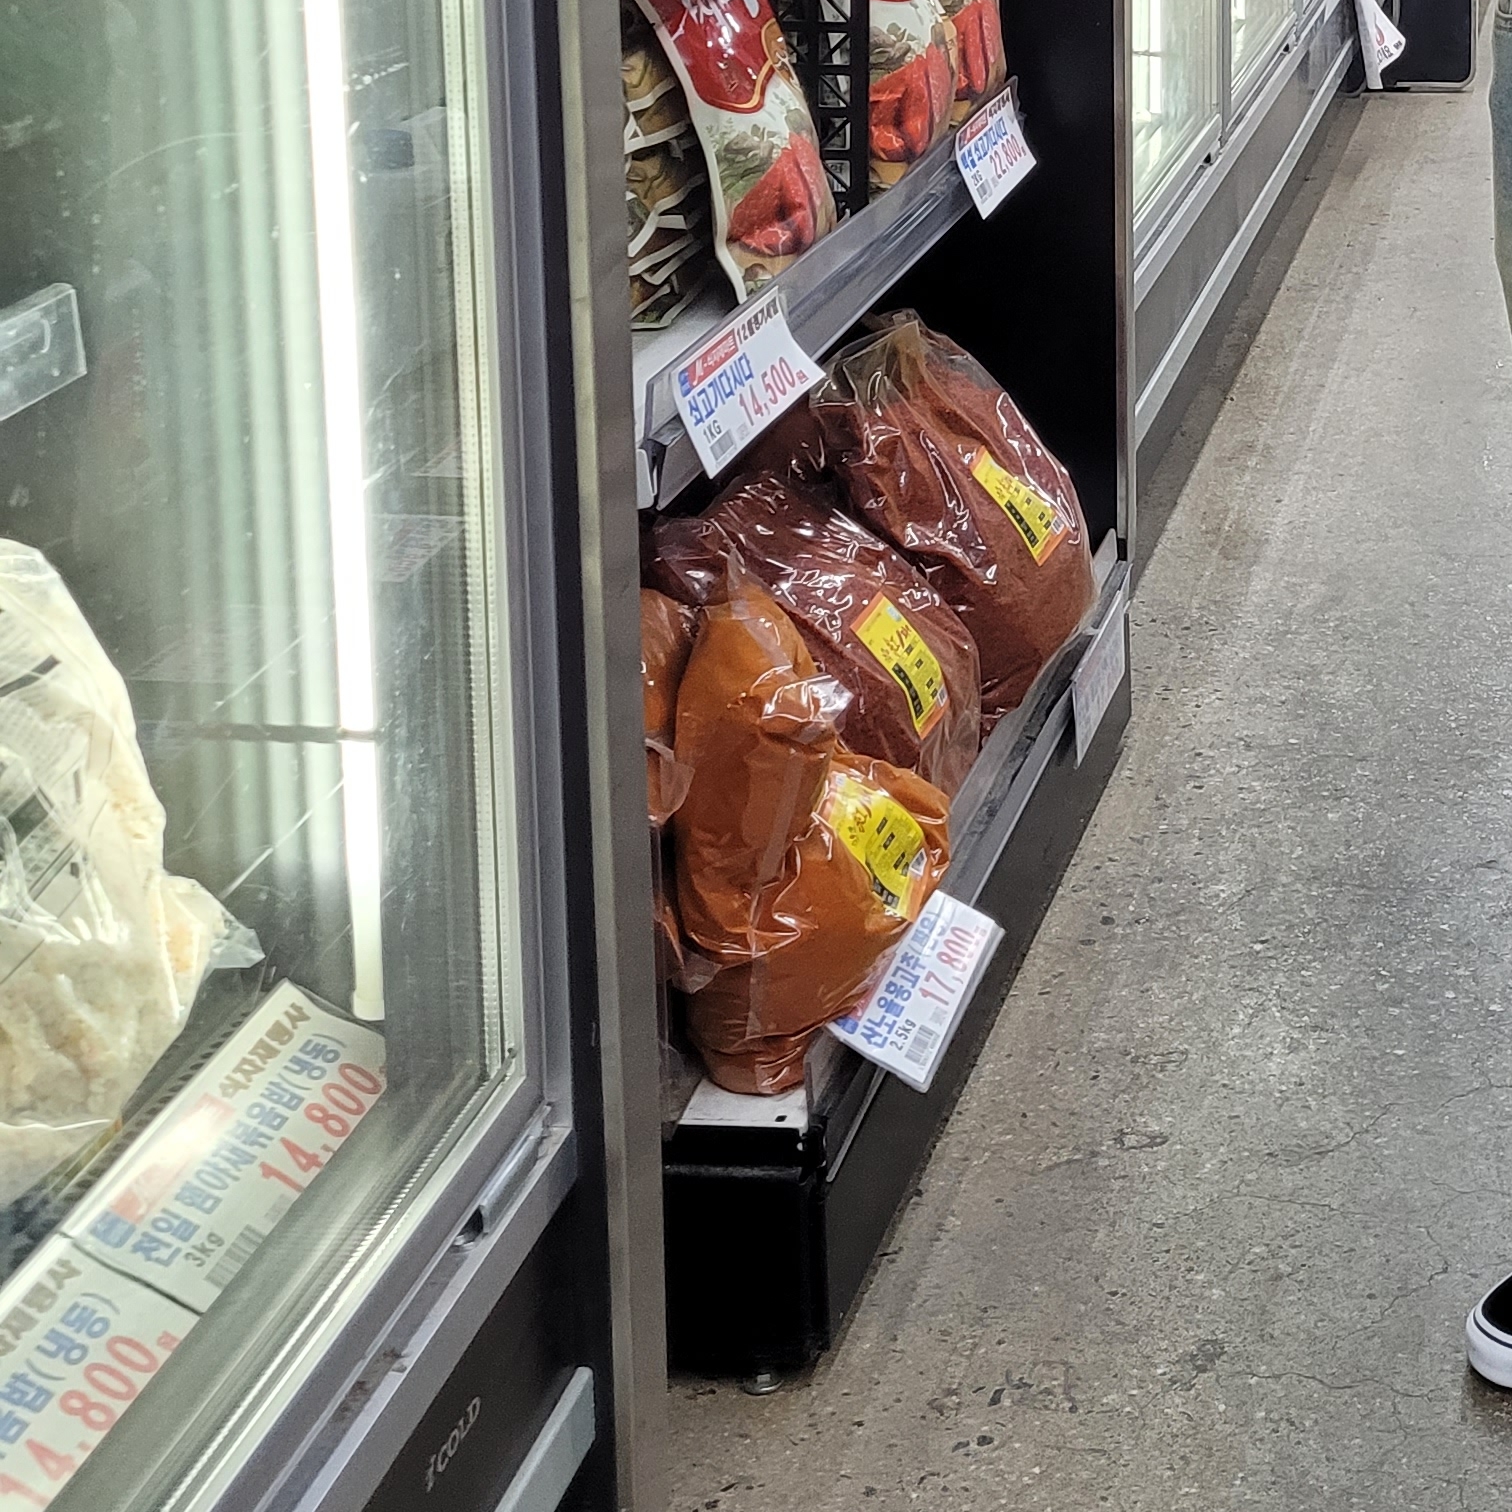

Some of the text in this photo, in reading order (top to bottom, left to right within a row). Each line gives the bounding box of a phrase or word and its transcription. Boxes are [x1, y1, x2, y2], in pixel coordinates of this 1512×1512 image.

[703, 419, 722, 444] 1KG
[219, 1001, 311, 1099] 식자재행사
[888, 1018, 917, 1051] 2.5kg
[184, 1230, 226, 1268] 3kg
